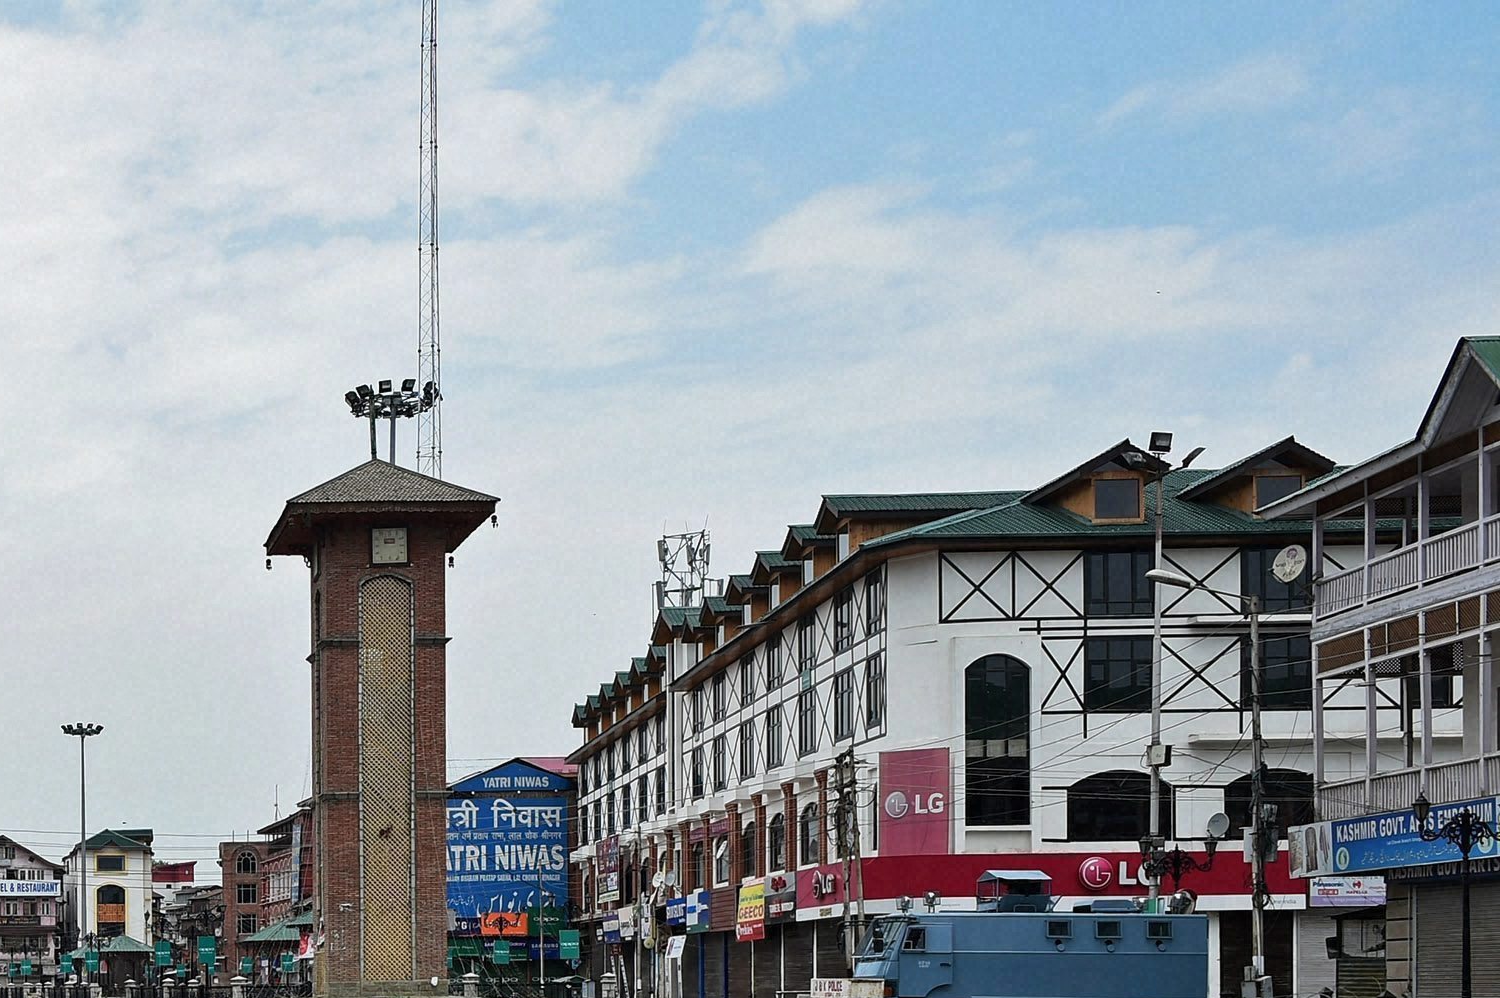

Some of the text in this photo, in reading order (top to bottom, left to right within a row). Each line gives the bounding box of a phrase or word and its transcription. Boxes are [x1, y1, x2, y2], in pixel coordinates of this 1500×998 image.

[483, 776, 549, 788] YATRI NIWAS
[491, 798, 562, 828] निवास
[914, 792, 945, 814] LG
[1336, 823, 1377, 844] KASHMIR
[1379, 816, 1406, 838] GOVT.
[495, 844, 564, 871] NIWAS
[1469, 858, 1500, 873] ARTS
[10, 882, 14, 892] &
[16, 882, 58, 892] RESTAURANT
[821, 873, 835, 894] LG
[828, 980, 843, 992] POLICE
